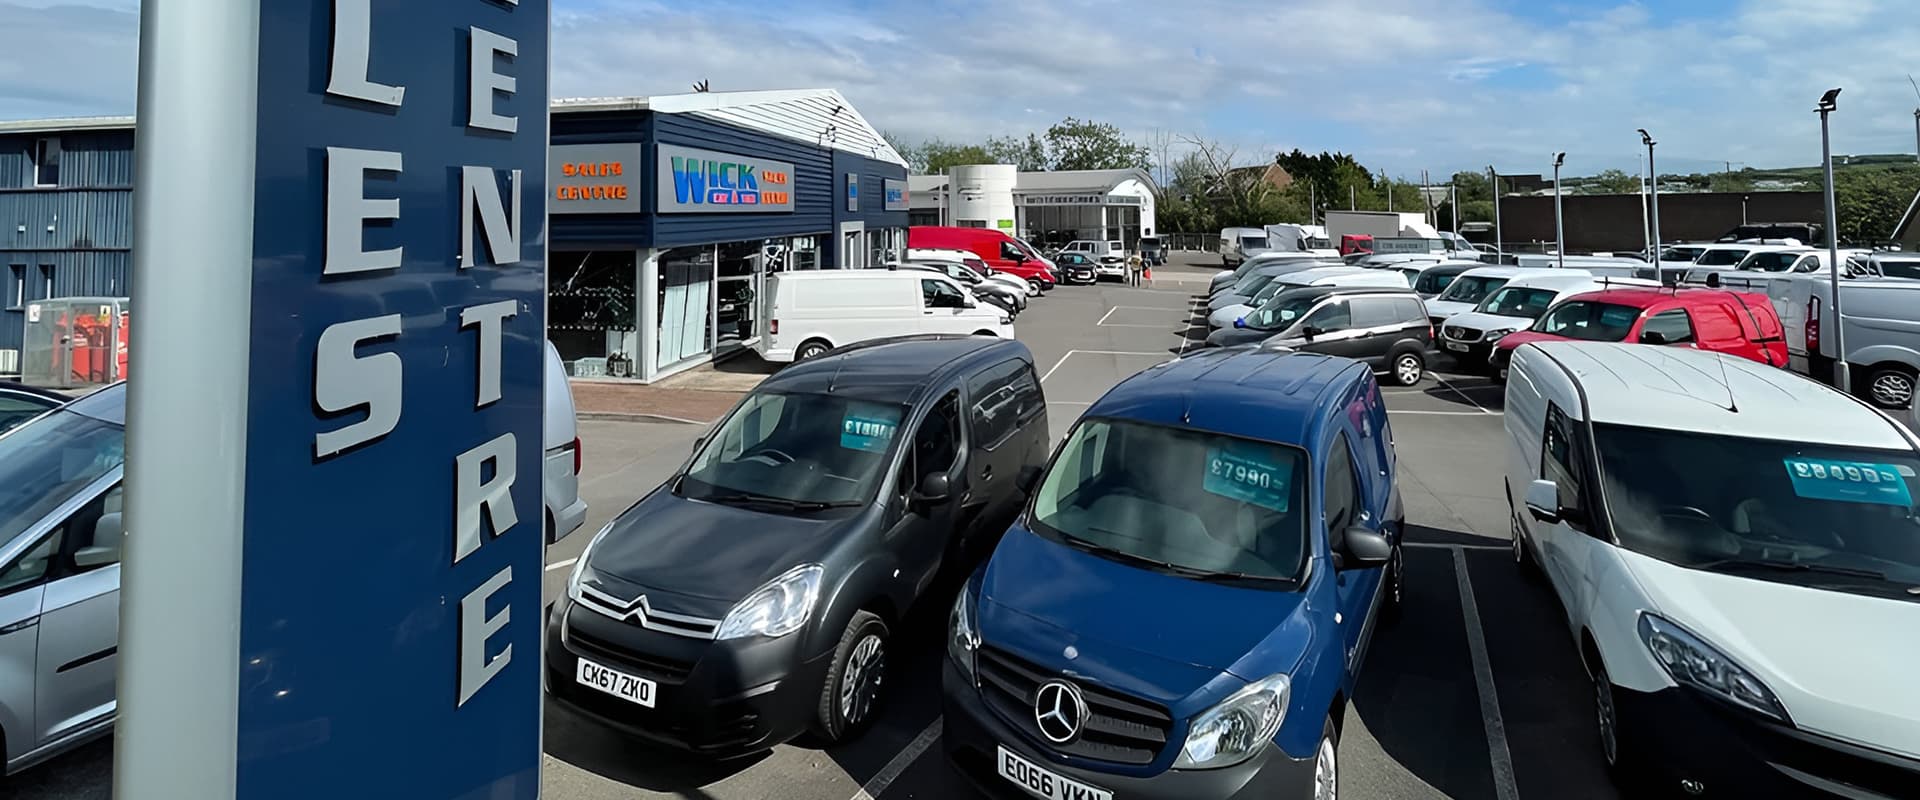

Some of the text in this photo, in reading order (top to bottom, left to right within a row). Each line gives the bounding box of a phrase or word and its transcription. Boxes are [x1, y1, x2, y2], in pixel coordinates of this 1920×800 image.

[671, 156, 757, 204] WICK
[455, 0, 521, 709] ENTRE
[583, 663, 618, 692] CK67
[1005, 753, 1054, 797] EO66
